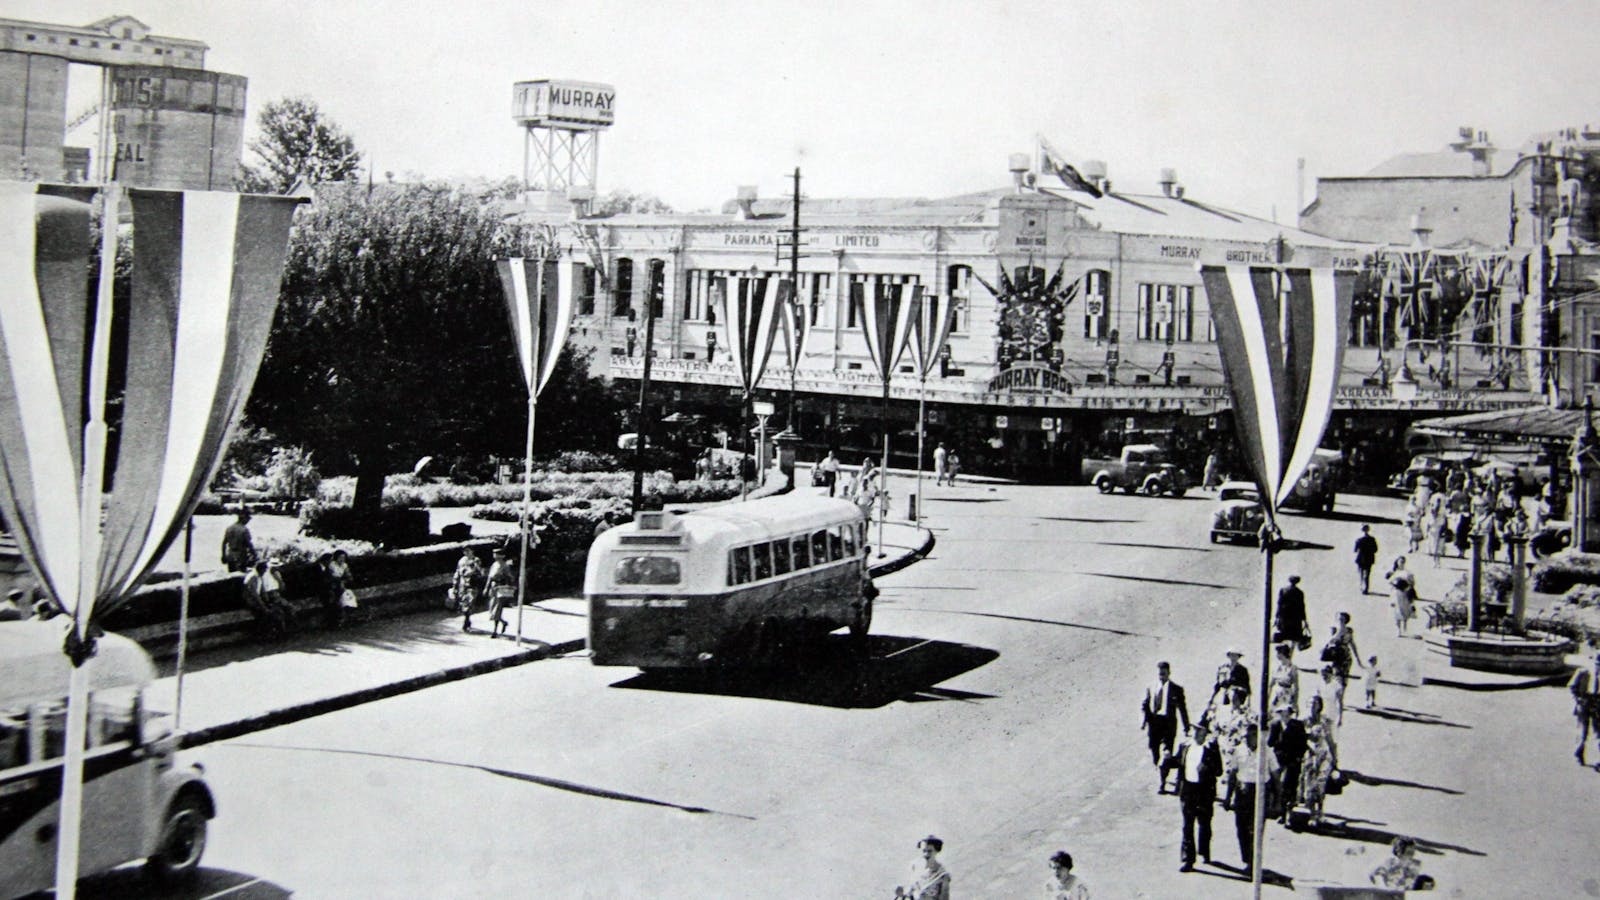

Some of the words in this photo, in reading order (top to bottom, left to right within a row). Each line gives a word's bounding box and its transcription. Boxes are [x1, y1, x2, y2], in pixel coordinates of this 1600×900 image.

[549, 86, 615, 109] MURRAY
[835, 235, 879, 247] LIMITED
[1161, 245, 1201, 260] MURRAY
[1226, 250, 1276, 265] BROTHER
[988, 367, 1039, 392] MURRAY
[1042, 369, 1072, 395] BROS
